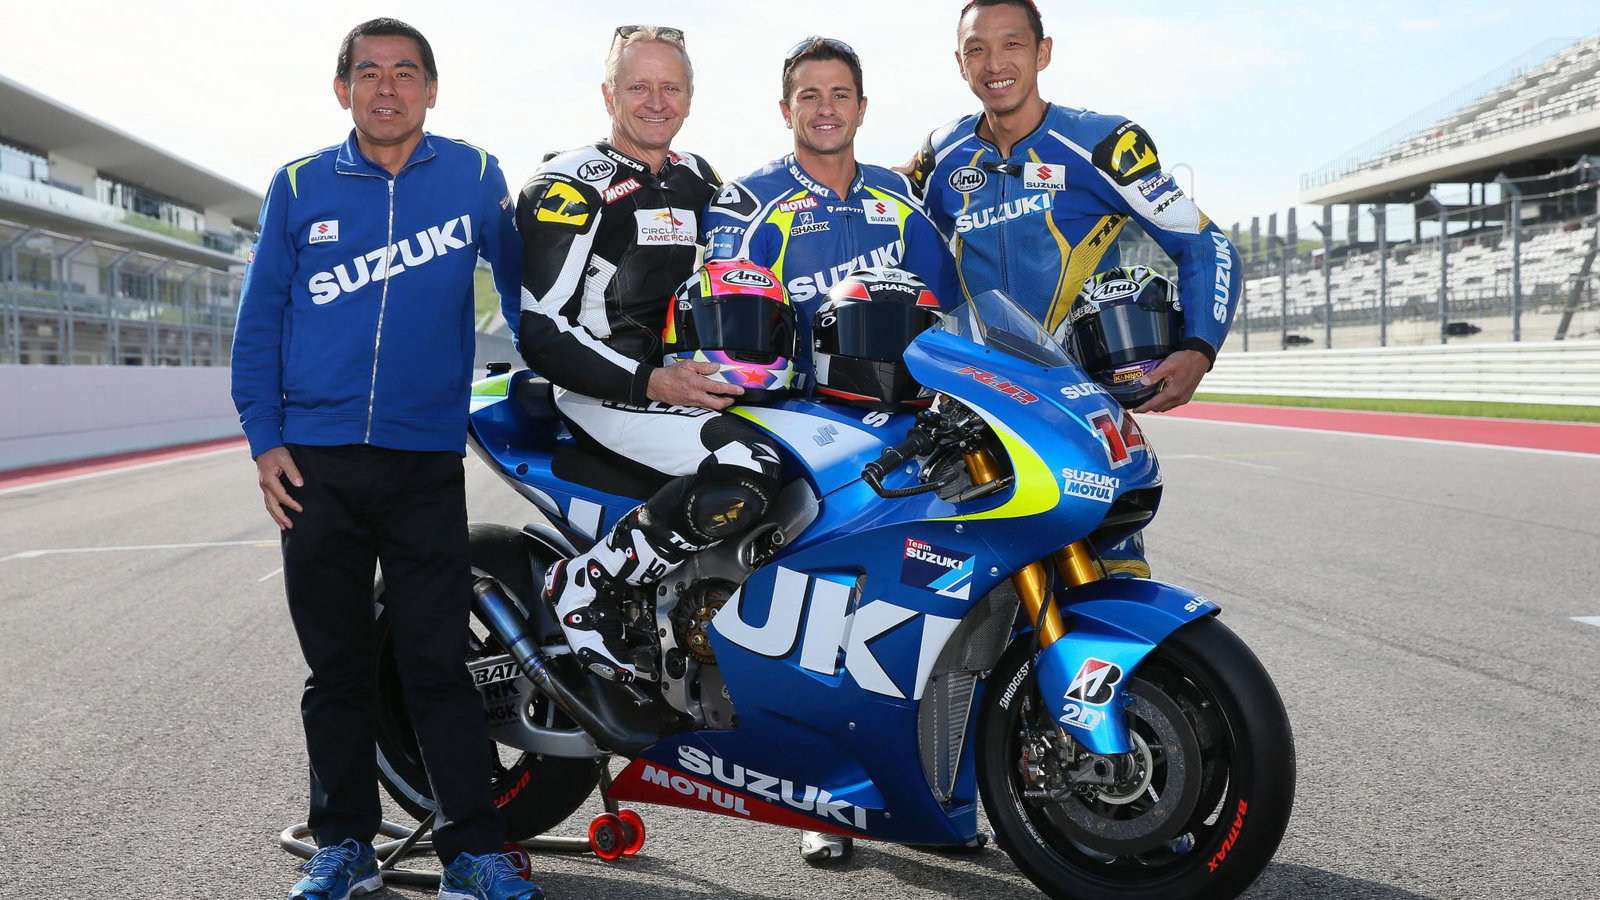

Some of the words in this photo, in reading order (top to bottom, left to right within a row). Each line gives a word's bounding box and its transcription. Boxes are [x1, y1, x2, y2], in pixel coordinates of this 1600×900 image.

[582, 161, 611, 180] Arai
[607, 150, 645, 173] TAICHI
[789, 165, 829, 198] SUZUKI
[954, 168, 980, 187] Arai
[1025, 181, 1065, 190] SUZUKI
[605, 178, 640, 203] MOTUL
[780, 197, 818, 213] MOTUL
[956, 192, 1051, 234] SUZUKI
[641, 227, 680, 235] CIRCUIT
[646, 234, 694, 243] AMERICAS
[791, 222, 829, 236] SHARK
[309, 214, 474, 305] SUZUKI
[727, 270, 769, 284] Arai
[787, 239, 904, 303] SUZUKI
[1213, 231, 1232, 324] SUZUKI
[869, 283, 917, 296] SHARK
[1092, 281, 1133, 300] Arai
[1085, 408, 1146, 470] 14
[1061, 467, 1119, 489] SUZUKI
[1066, 482, 1113, 500] MOTUL
[908, 538, 932, 551] Team
[906, 547, 964, 570] SUZUKI
[641, 764, 750, 816] MOTUL
[677, 744, 867, 830] SUZUKI
[1207, 799, 1248, 873] BATTLAX
